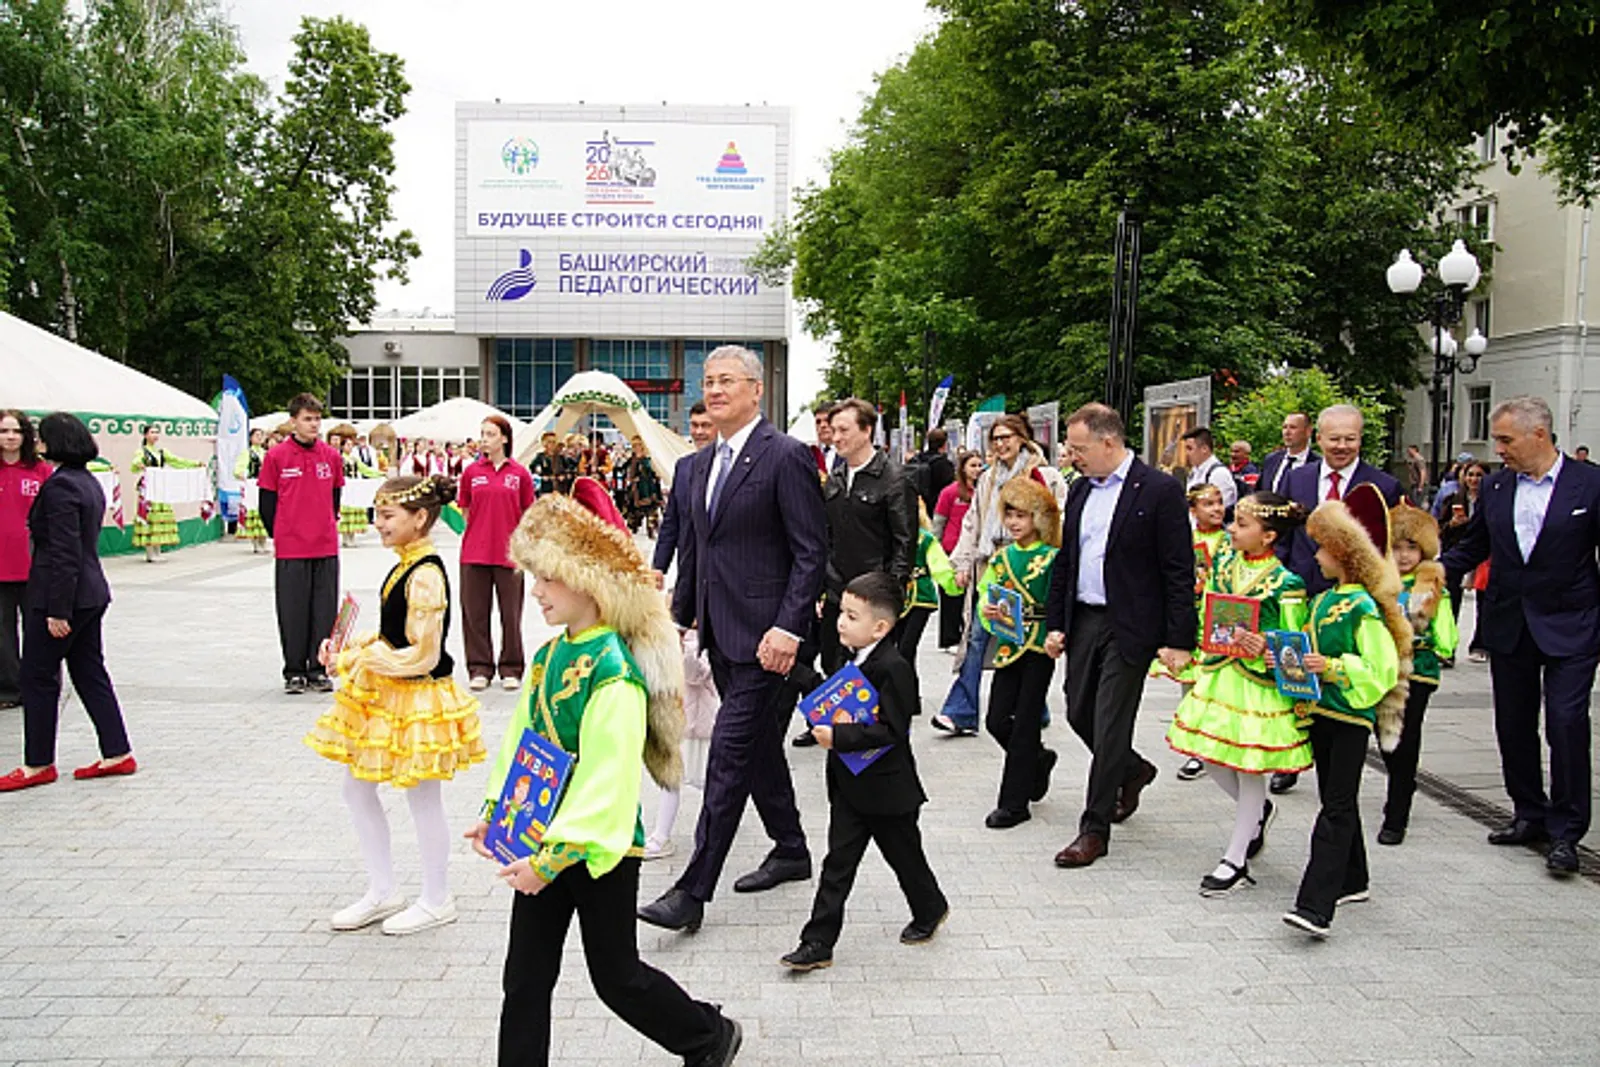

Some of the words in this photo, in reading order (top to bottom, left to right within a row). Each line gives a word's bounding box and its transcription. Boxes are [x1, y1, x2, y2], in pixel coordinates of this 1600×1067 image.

[586, 146, 610, 164] 20
[586, 164, 610, 181] 26
[478, 212, 567, 228] БУДУЩЕЕ
[571, 213, 667, 229] СТРОИТСЯ
[671, 215, 763, 231] СЕГОДНЯ!
[559, 251, 707, 273] БАШКИРСКИЙ
[559, 273, 759, 296] ПЕДАГОГИЧЕСКИЙ
